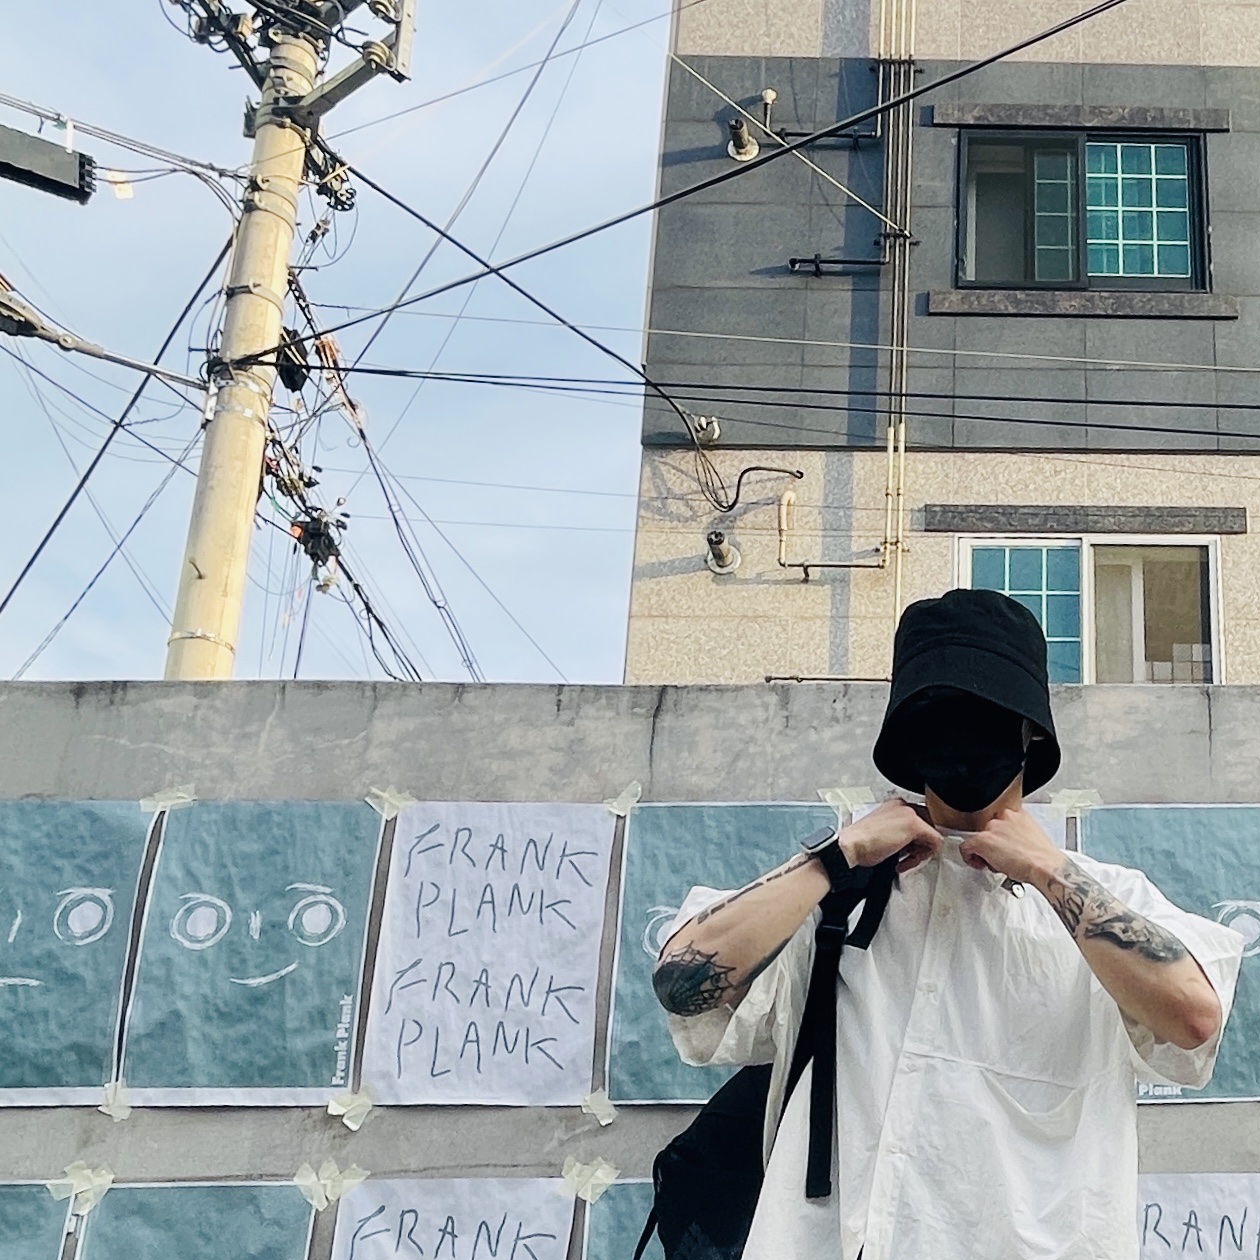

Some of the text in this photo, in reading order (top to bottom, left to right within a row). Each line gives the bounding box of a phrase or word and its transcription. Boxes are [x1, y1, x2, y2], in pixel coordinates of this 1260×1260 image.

[404, 823, 599, 887] FRANK
[415, 881, 577, 939] PLANK
[384, 958, 585, 1025] FRANK
[331, 994, 354, 1086] Frank Plank
[397, 1018, 564, 1080] PLANK
[1138, 1083, 1183, 1097] Plank
